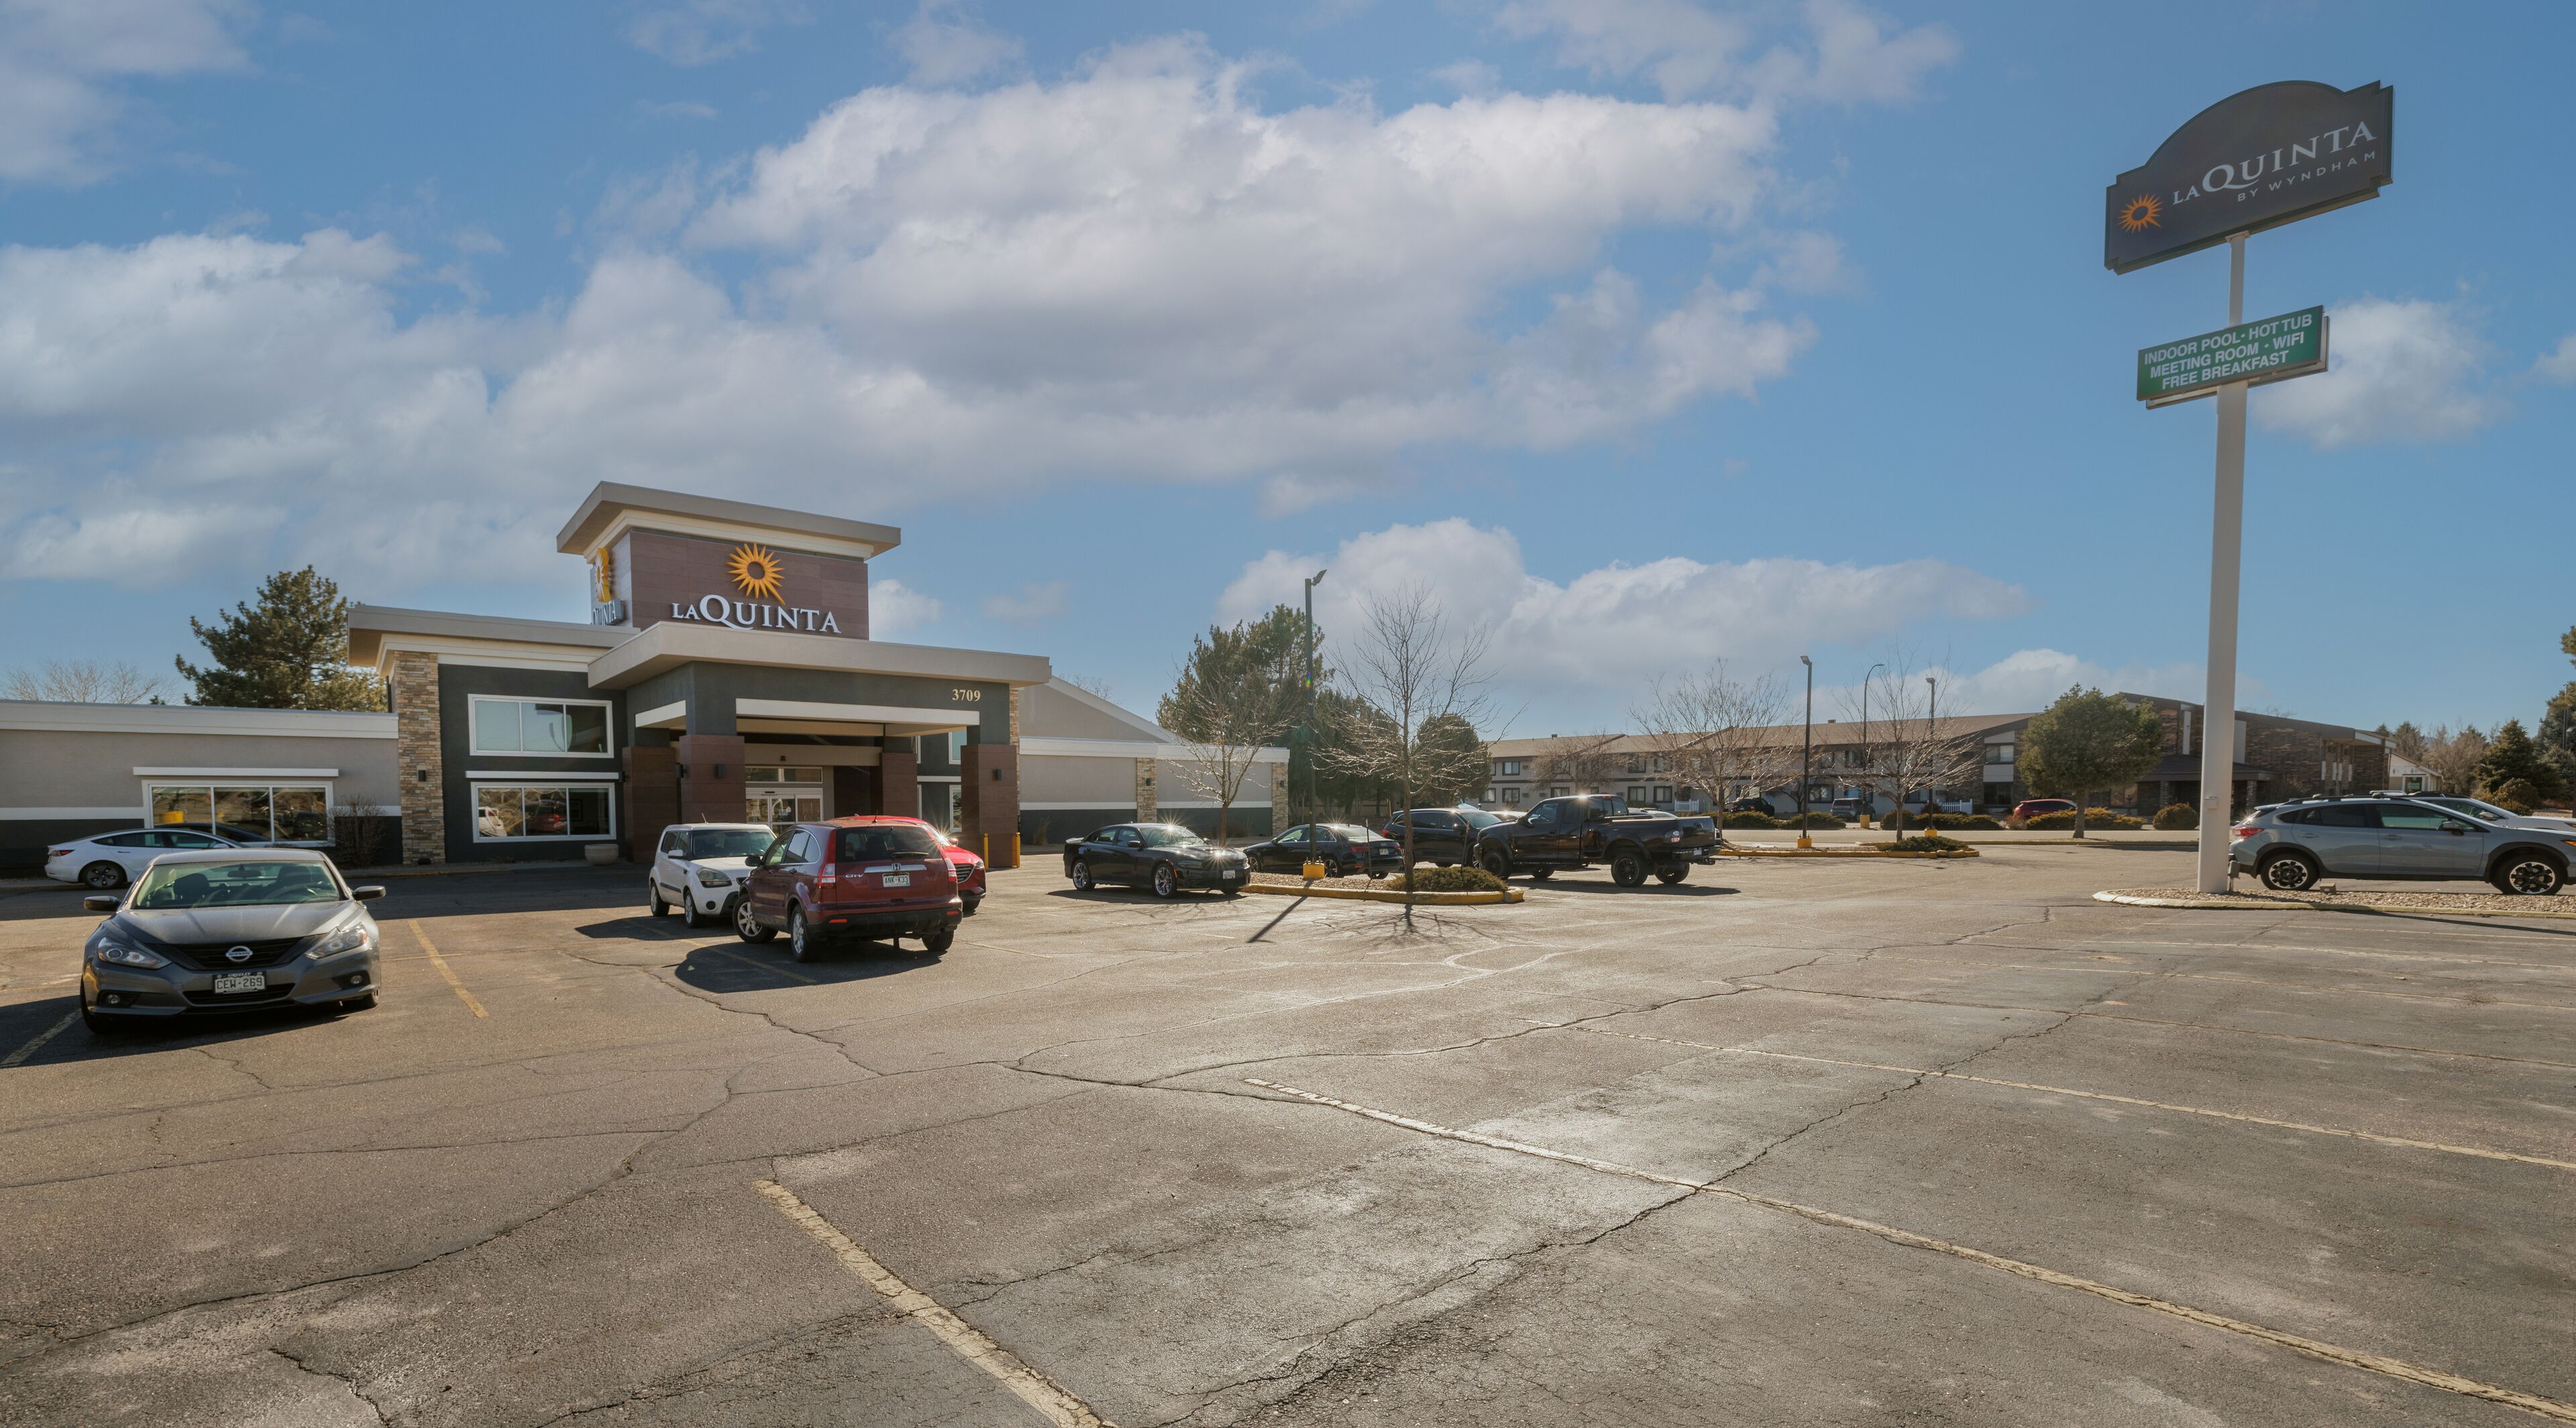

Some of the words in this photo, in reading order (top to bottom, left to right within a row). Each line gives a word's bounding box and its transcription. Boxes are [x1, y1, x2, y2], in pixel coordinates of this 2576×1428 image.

[2172, 185, 2200, 205] LA
[2202, 121, 2377, 193] QUINTA
[2237, 188, 2259, 202] BY
[2268, 150, 2376, 192] WYNDHAM
[2144, 342, 2198, 365] INDOOR
[2249, 321, 2279, 340] HOT
[2282, 313, 2312, 332] TUB
[2150, 355, 2211, 378] MEETING
[2215, 342, 2259, 364] ROOM
[2273, 331, 2304, 349] WIFI
[2162, 371, 2198, 390] FREE
[2202, 350, 2289, 381] BREAKFAST
[672, 603, 700, 620] LA
[700, 594, 842, 633] QUINTA
[952, 688, 981, 702] 3709
